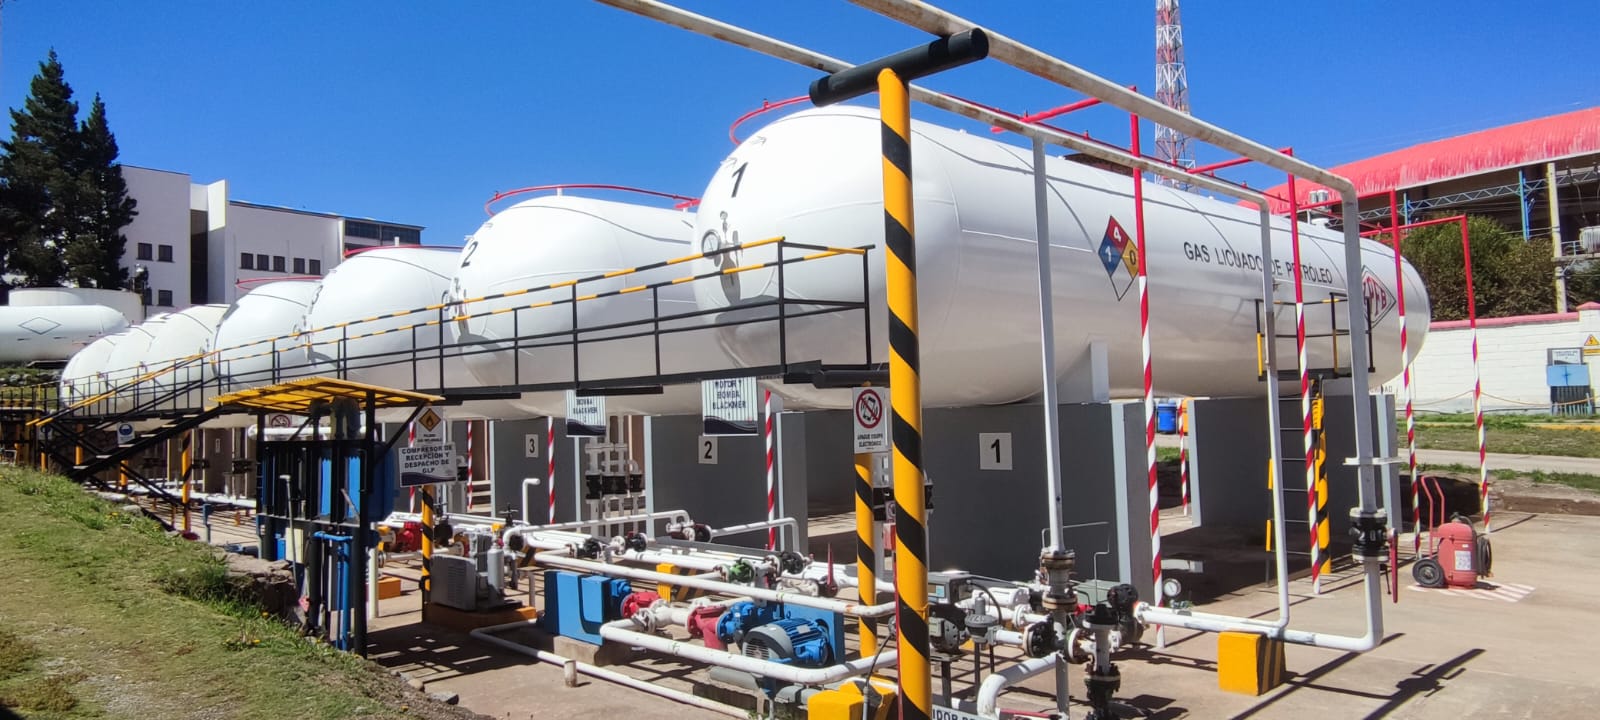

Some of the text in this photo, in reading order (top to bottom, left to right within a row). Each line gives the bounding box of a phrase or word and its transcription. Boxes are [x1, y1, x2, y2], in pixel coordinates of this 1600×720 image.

[731, 161, 749, 198] 1
[1113, 226, 1122, 242] 4
[461, 241, 478, 268] 2
[1105, 246, 1112, 262] 1
[1129, 249, 1136, 266] 0
[1183, 241, 1211, 263] GAS
[1214, 247, 1263, 272] LICUADO
[1285, 261, 1333, 284] PRÓLEO
[401, 446, 443, 455] COMPRESOR
[529, 438, 535, 454] 3
[704, 440, 713, 460] 2
[990, 438, 1001, 464] 1
[404, 460, 440, 469] DESPACHO
